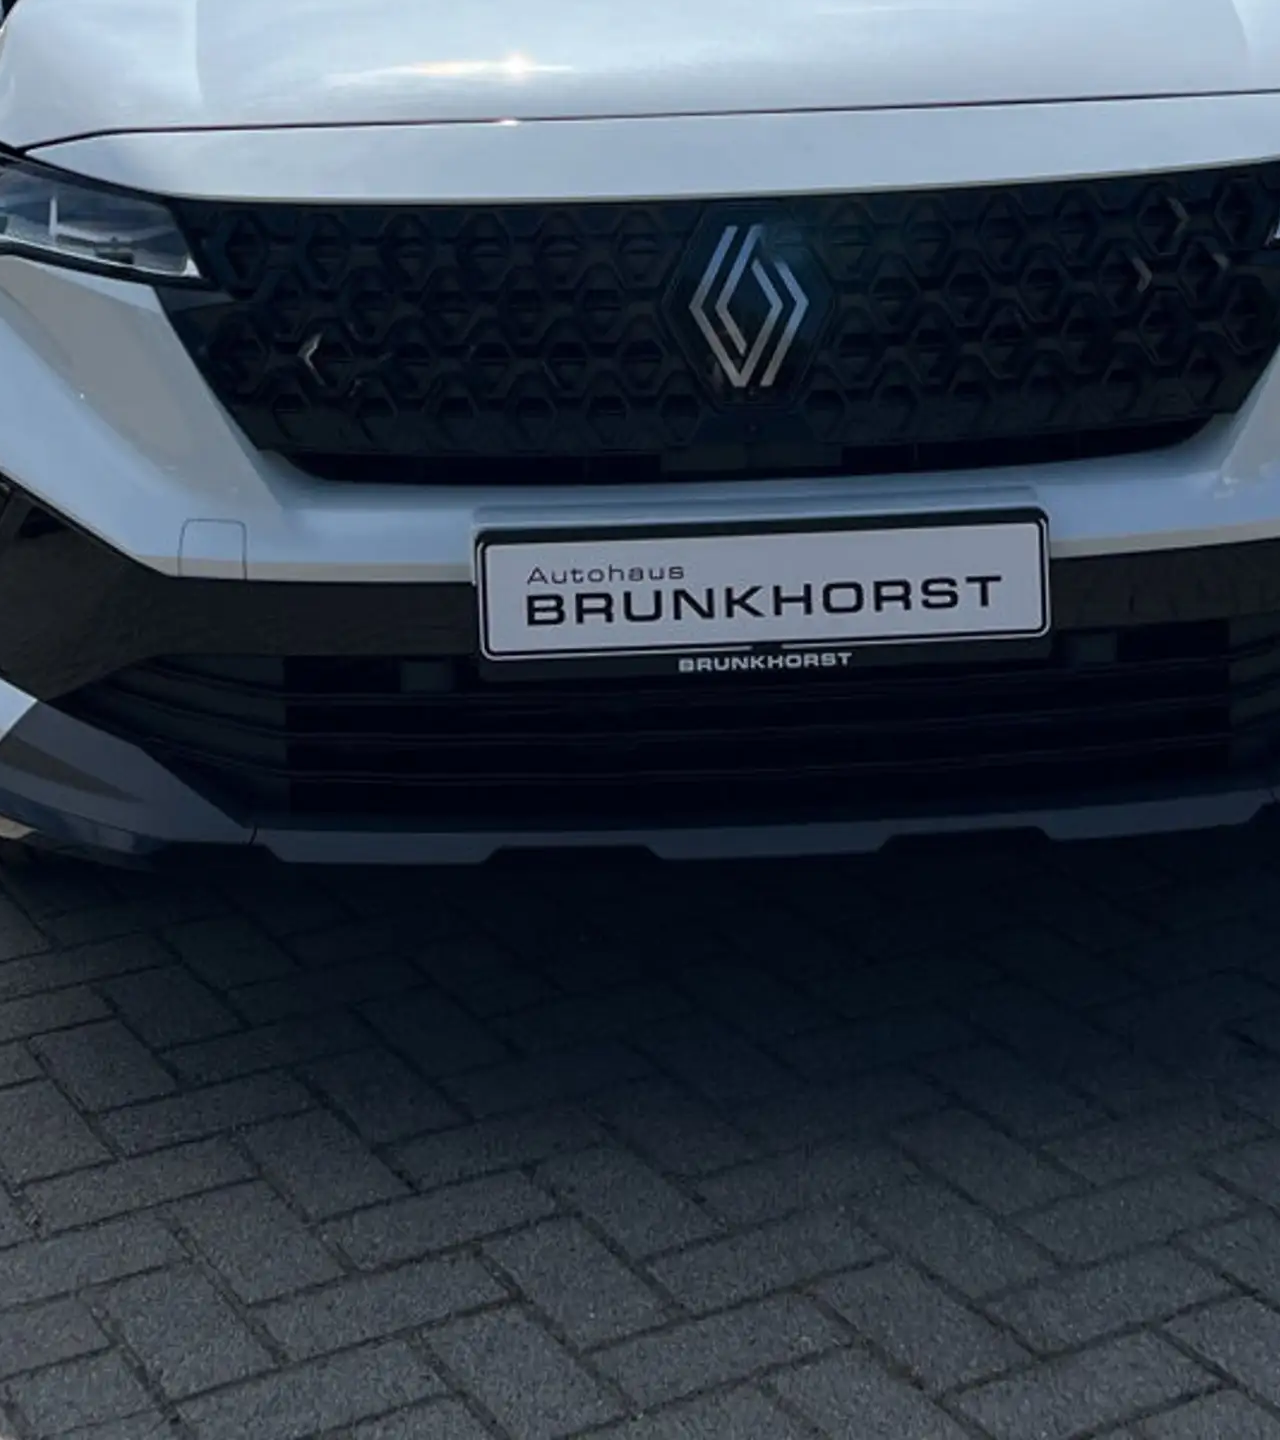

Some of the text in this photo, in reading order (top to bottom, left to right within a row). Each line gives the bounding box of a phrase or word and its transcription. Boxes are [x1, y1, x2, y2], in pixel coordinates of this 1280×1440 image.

[526, 564, 685, 585] Autohaus
[525, 575, 1003, 627] BRUNKHORST
[678, 652, 853, 673] BRUNKHORST
